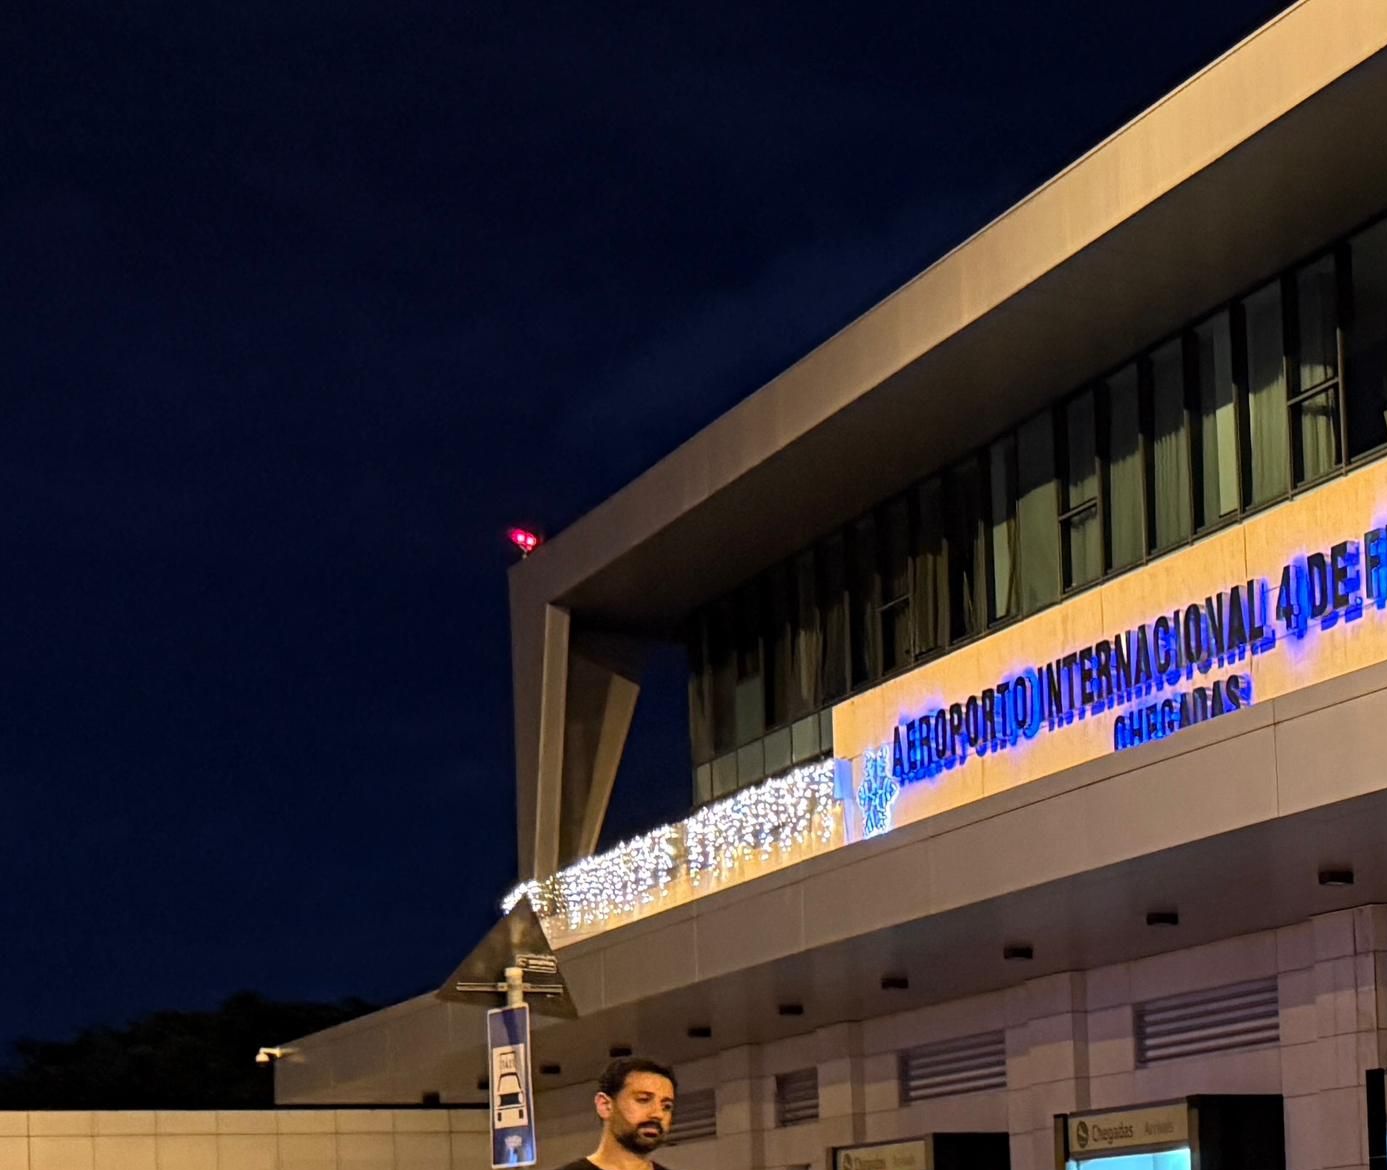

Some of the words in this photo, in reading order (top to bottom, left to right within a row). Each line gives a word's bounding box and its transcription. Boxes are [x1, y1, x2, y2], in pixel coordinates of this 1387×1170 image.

[893, 674, 1037, 782] AEROPORTO
[1037, 578, 1270, 726] INTERNACIONAL
[1276, 564, 1305, 634] 4
[1307, 540, 1358, 625] DE
